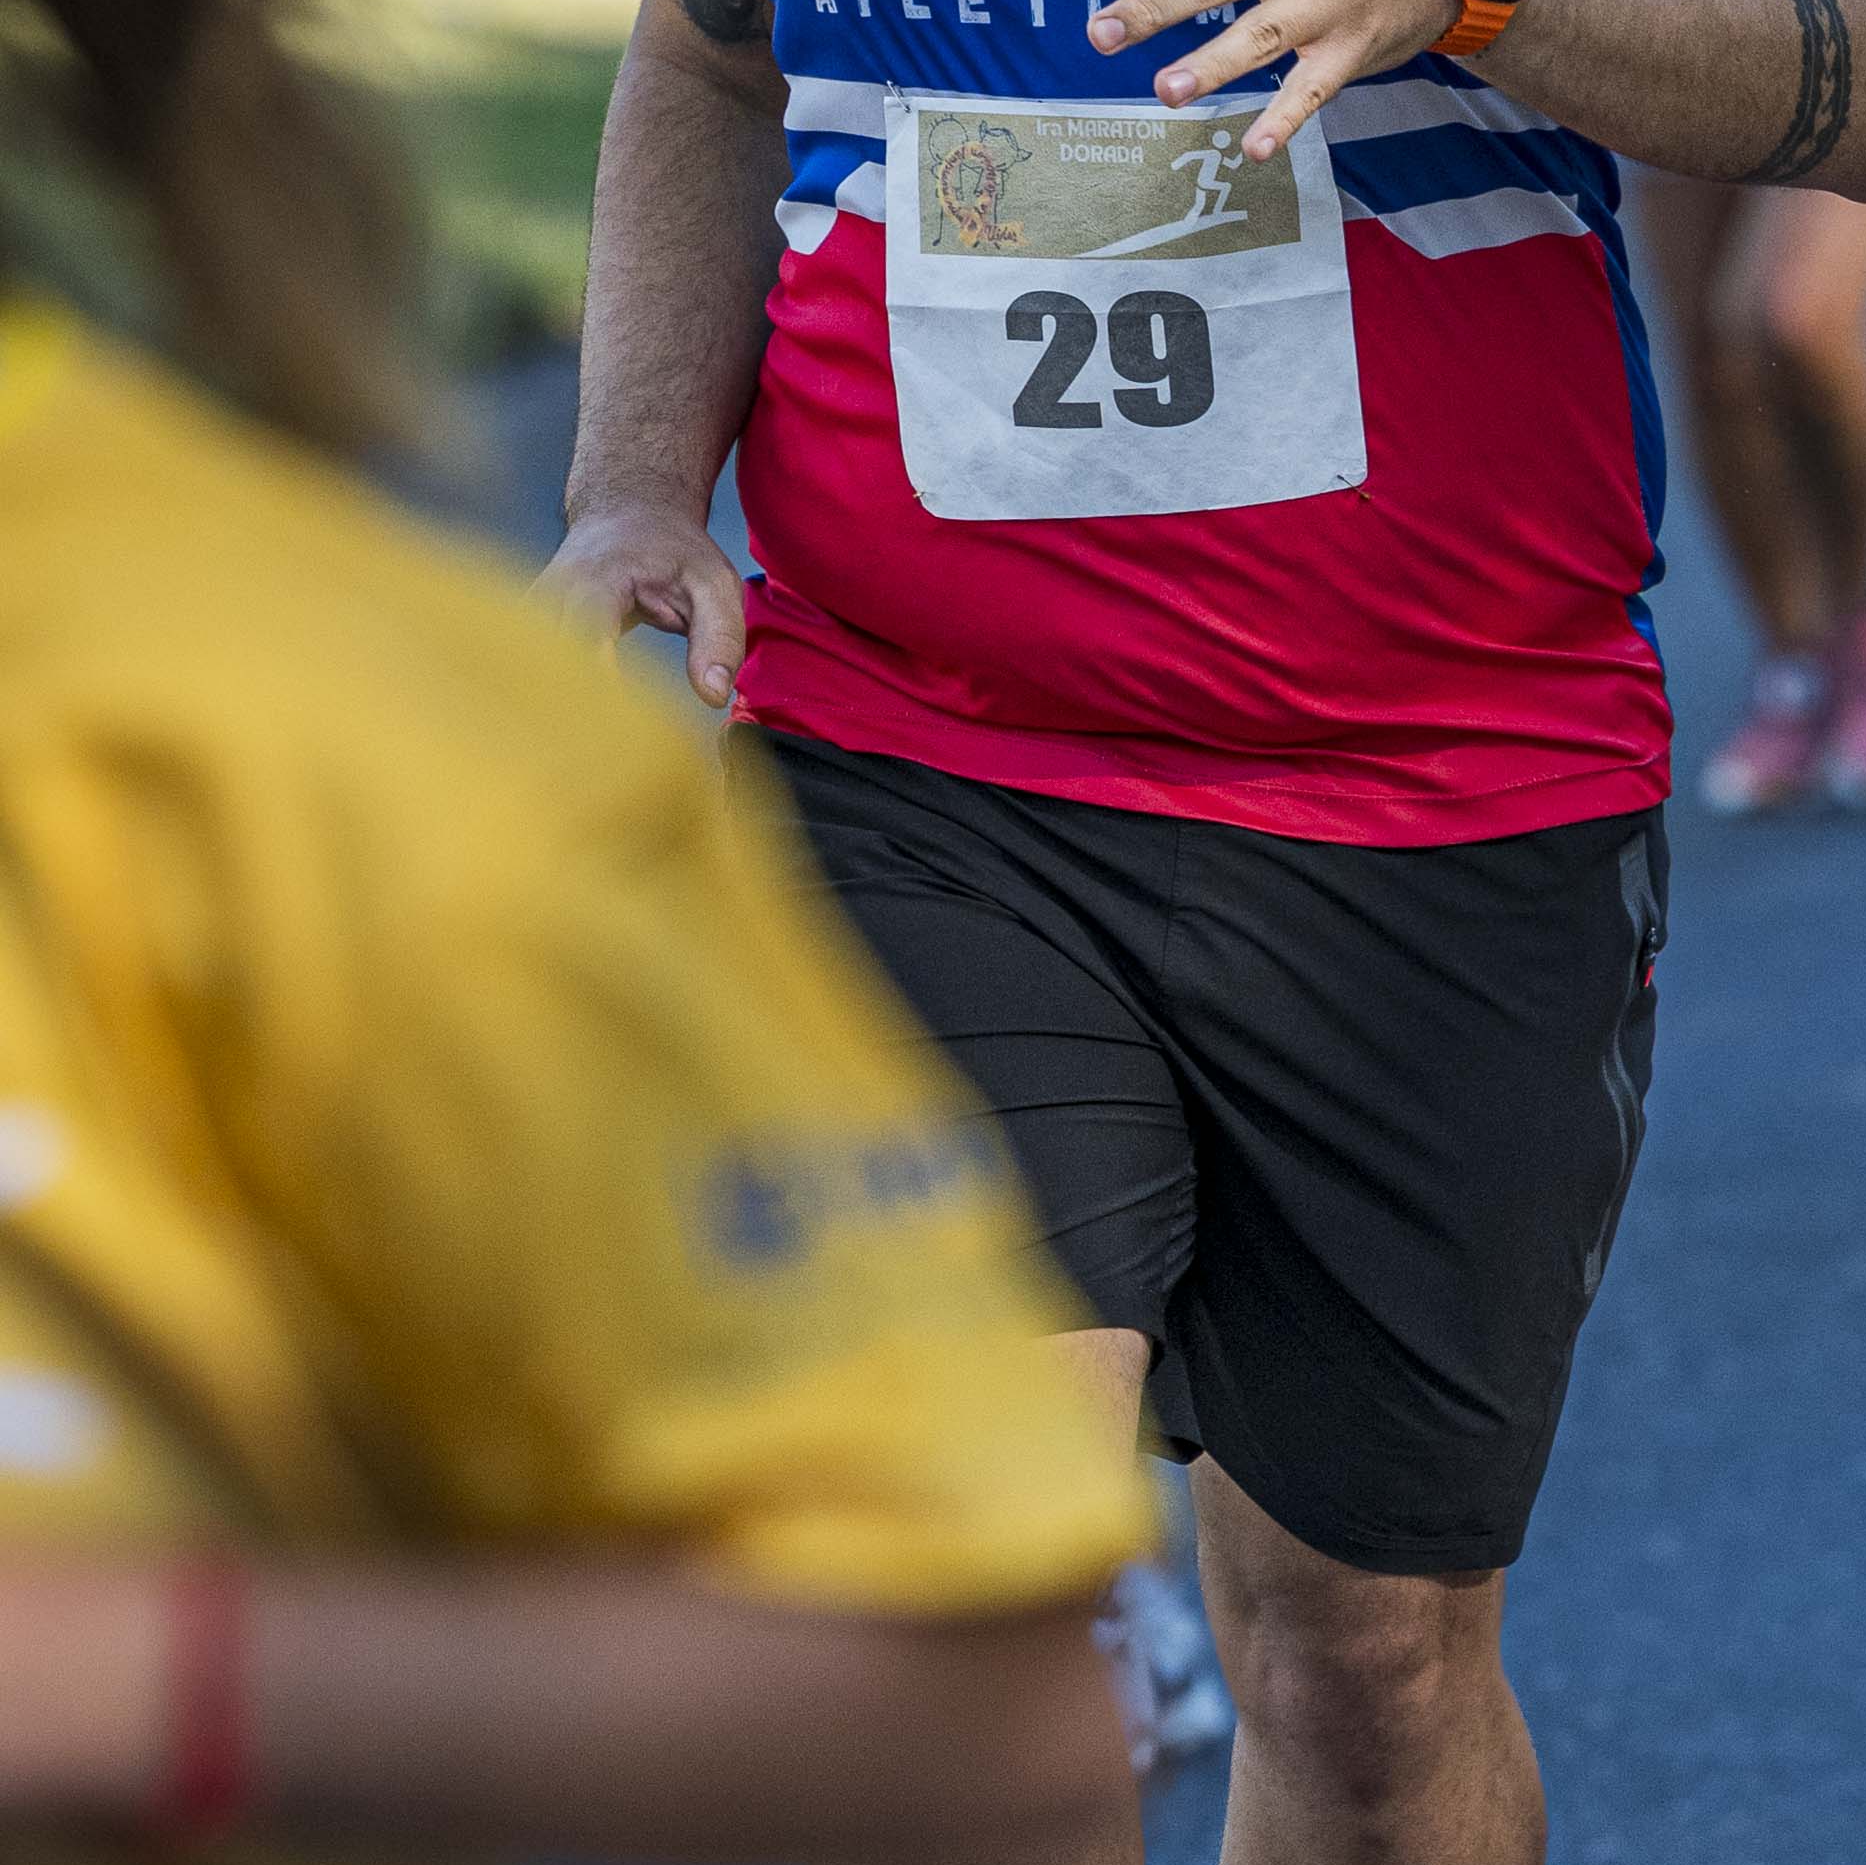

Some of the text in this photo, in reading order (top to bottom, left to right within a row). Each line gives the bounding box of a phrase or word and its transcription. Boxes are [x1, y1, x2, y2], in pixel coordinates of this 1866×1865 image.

[1067, 118, 1167, 140] MARATON
[1060, 143, 1144, 164] DORADA
[1005, 290, 1215, 428] 29
